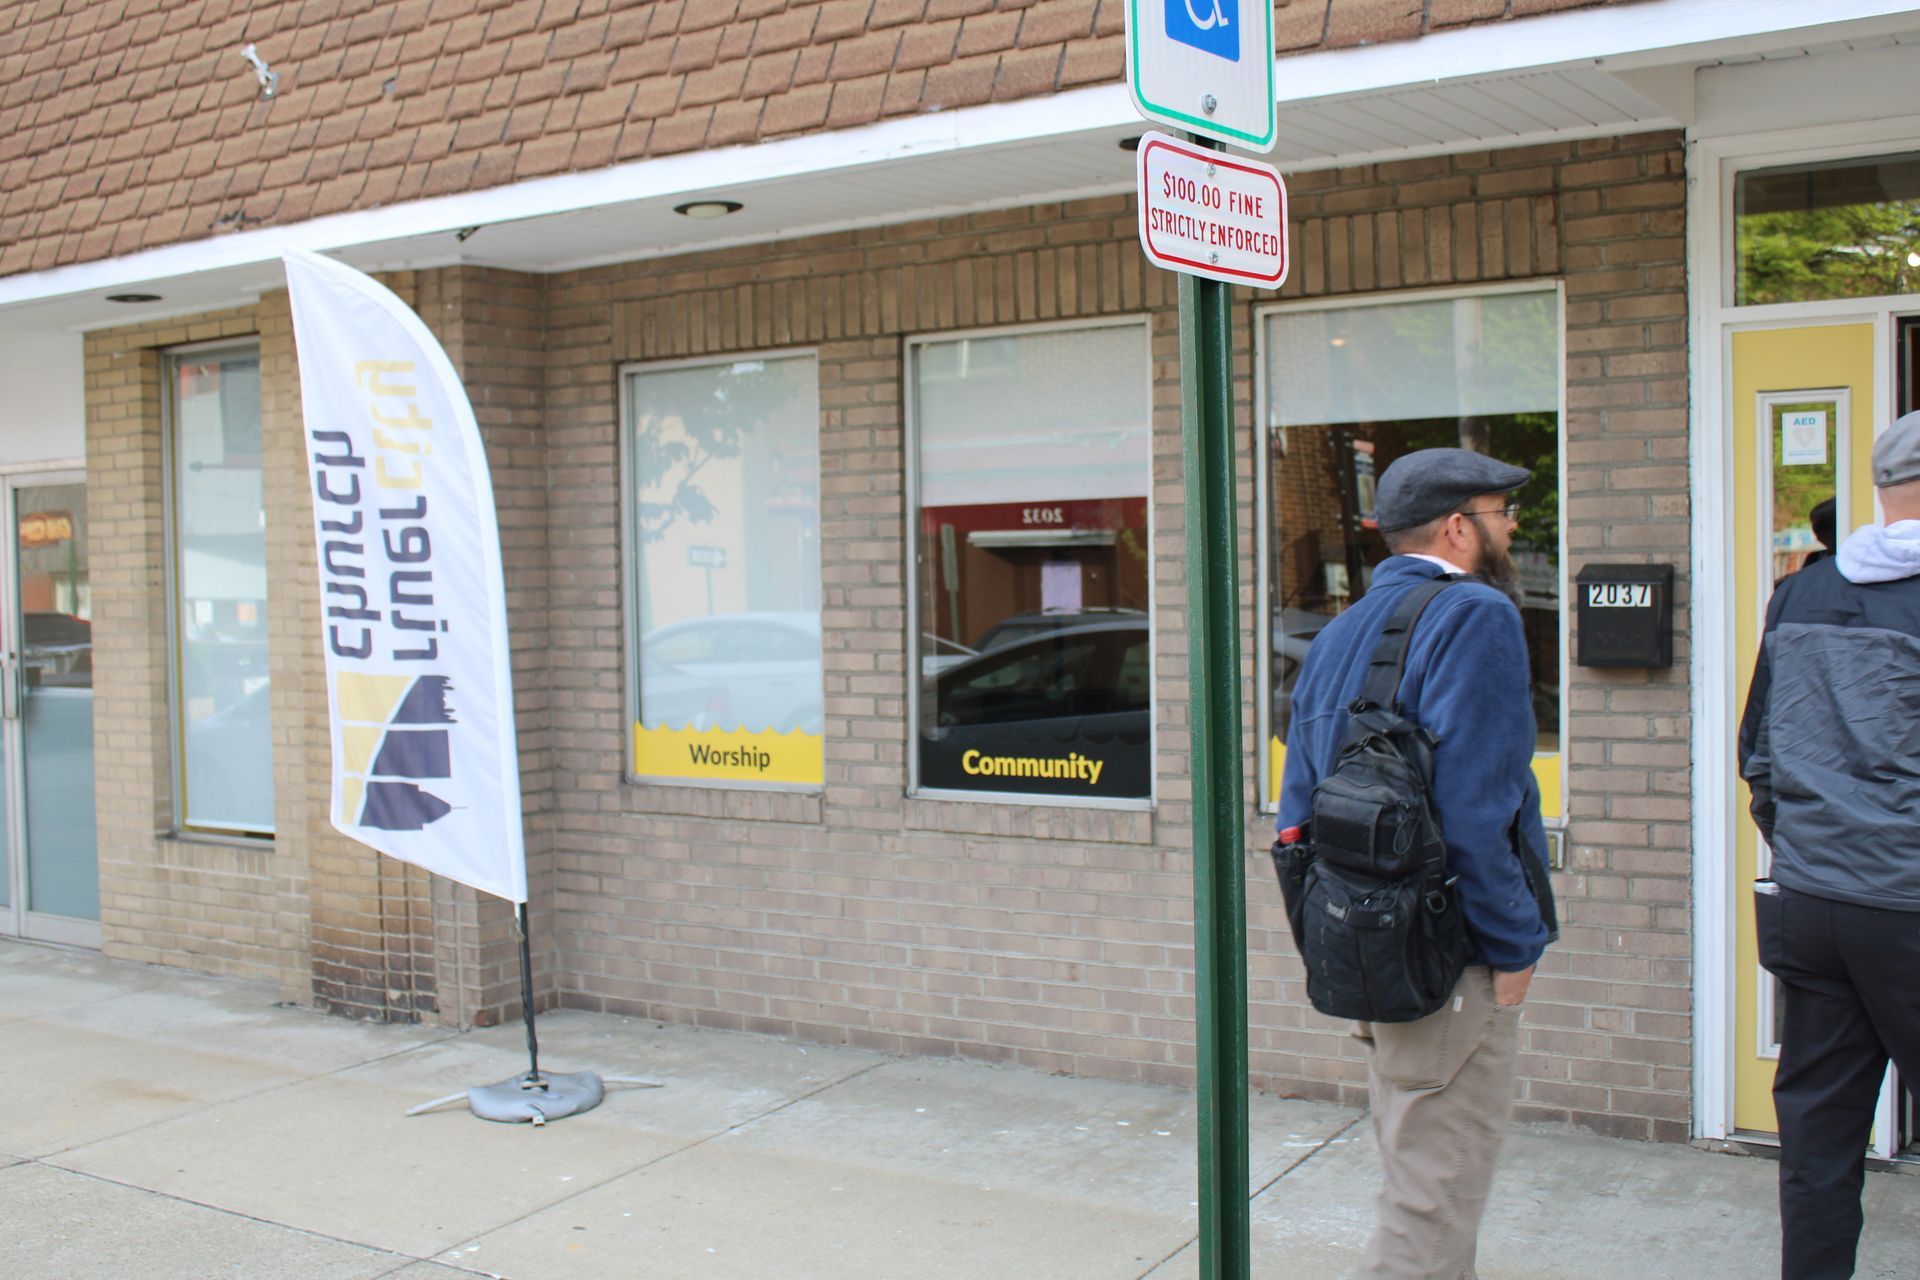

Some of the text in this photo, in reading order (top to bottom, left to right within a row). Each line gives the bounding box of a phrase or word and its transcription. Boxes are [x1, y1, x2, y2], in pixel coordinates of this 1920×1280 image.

[1163, 171, 1264, 219] $100.00 FINE
[1151, 207, 1278, 257] STRICTLY ENFORCED
[1793, 417, 1816, 426] AED
[1592, 584, 1648, 605] 2037
[689, 743, 771, 772] Worship
[962, 749, 1103, 785] Community
